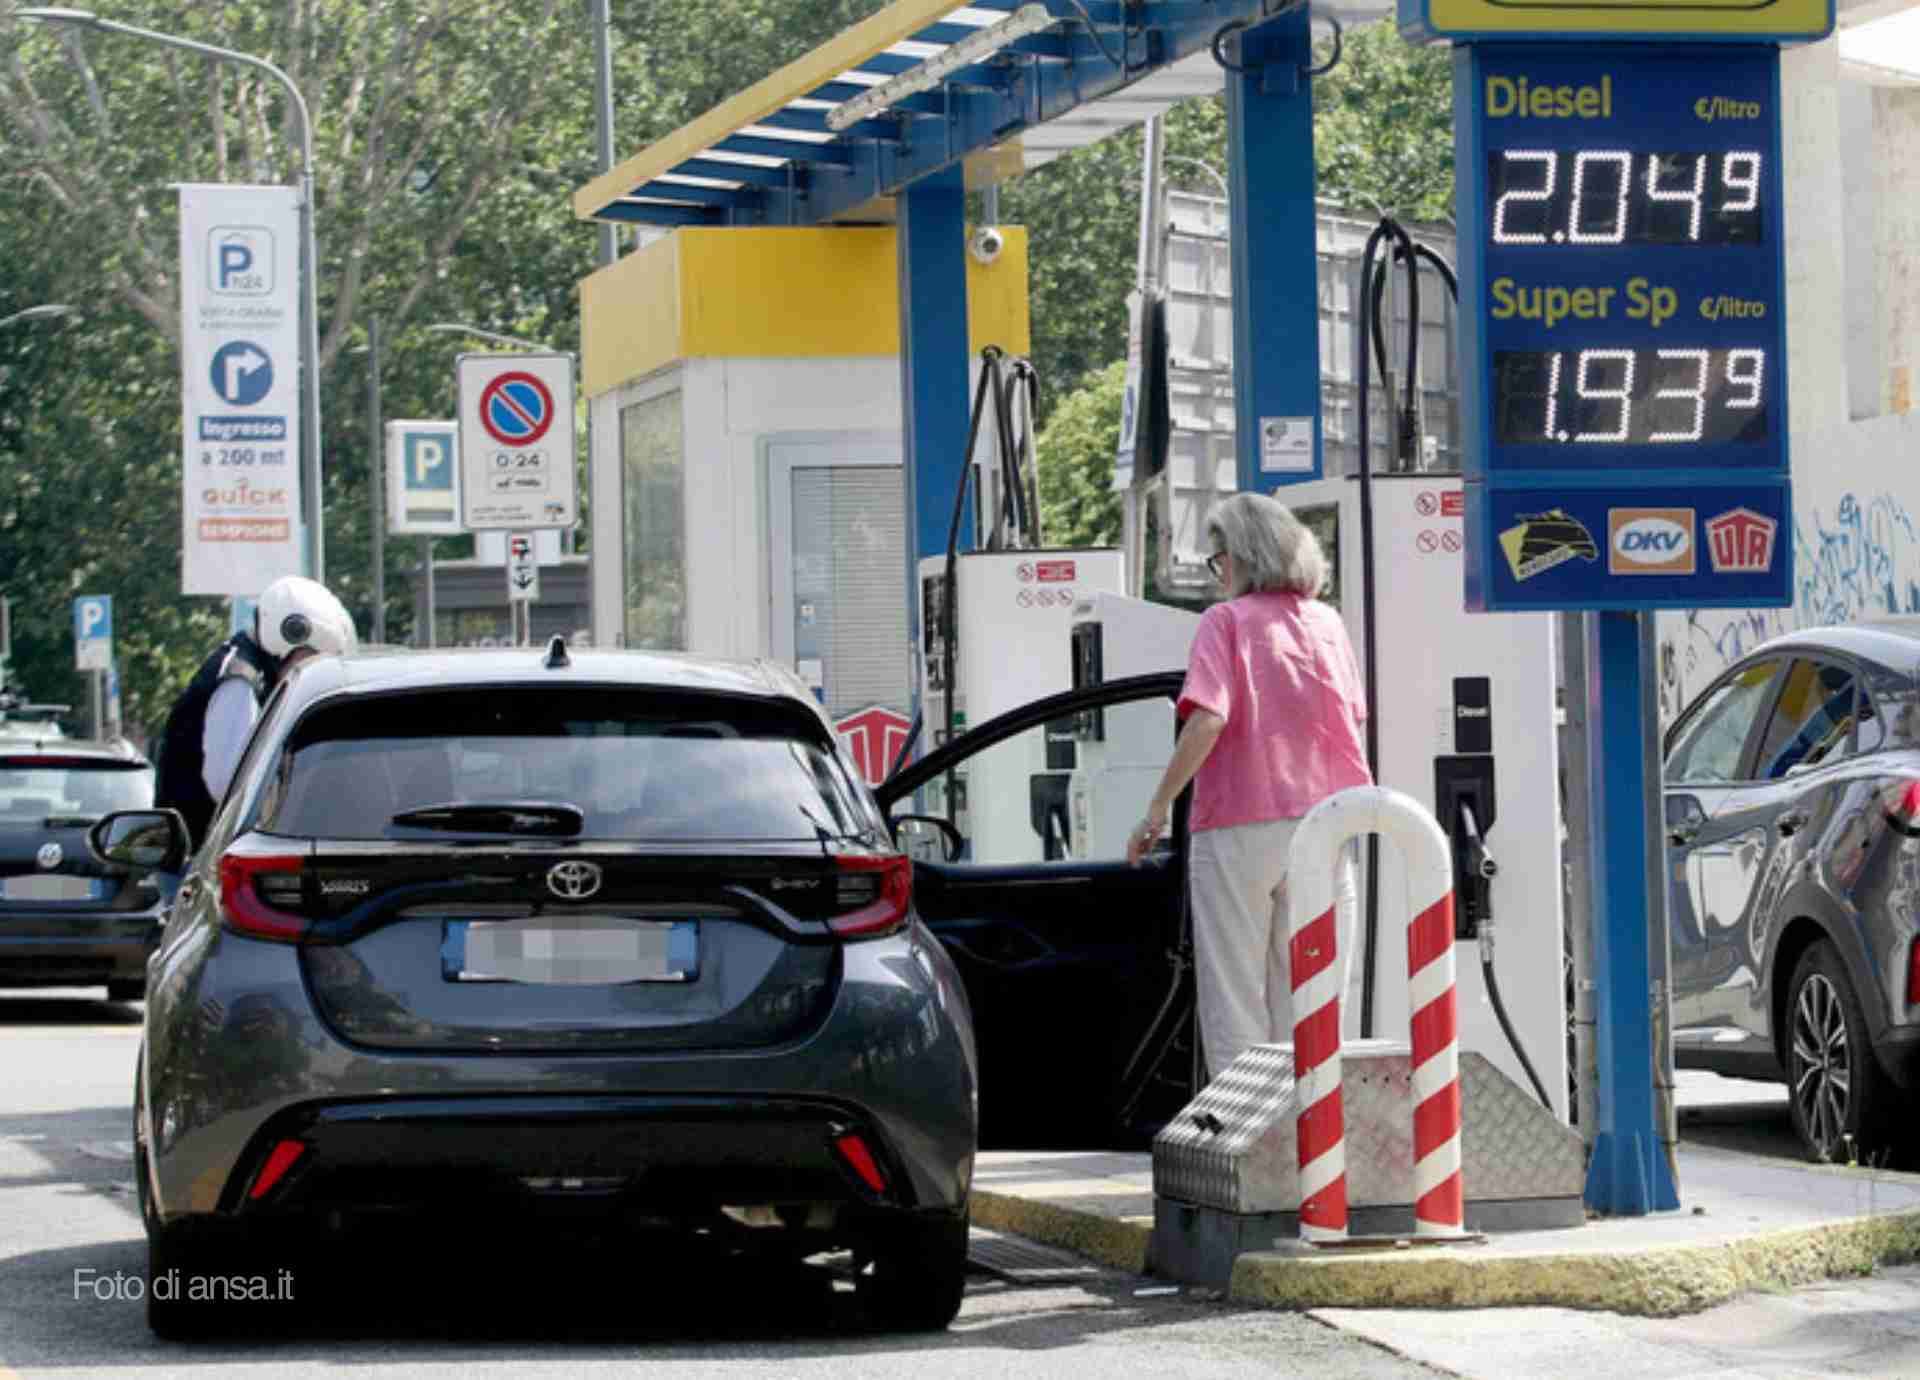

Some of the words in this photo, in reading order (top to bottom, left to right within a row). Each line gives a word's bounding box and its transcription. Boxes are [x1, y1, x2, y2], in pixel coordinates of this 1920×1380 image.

[1484, 74, 1612, 118] Diesel
[1694, 96, 1761, 122] €/litro
[220, 244, 253, 288] P
[1490, 276, 1617, 328] Super
[1625, 277, 1679, 328] Sp
[1699, 295, 1766, 321] €/litro
[202, 418, 286, 440] Ingresso
[201, 451, 211, 465] a
[218, 448, 255, 466] 200
[416, 440, 444, 483] P
[1621, 530, 1683, 551] DKV
[1711, 514, 1771, 567] UTA
[81, 602, 103, 636] P
